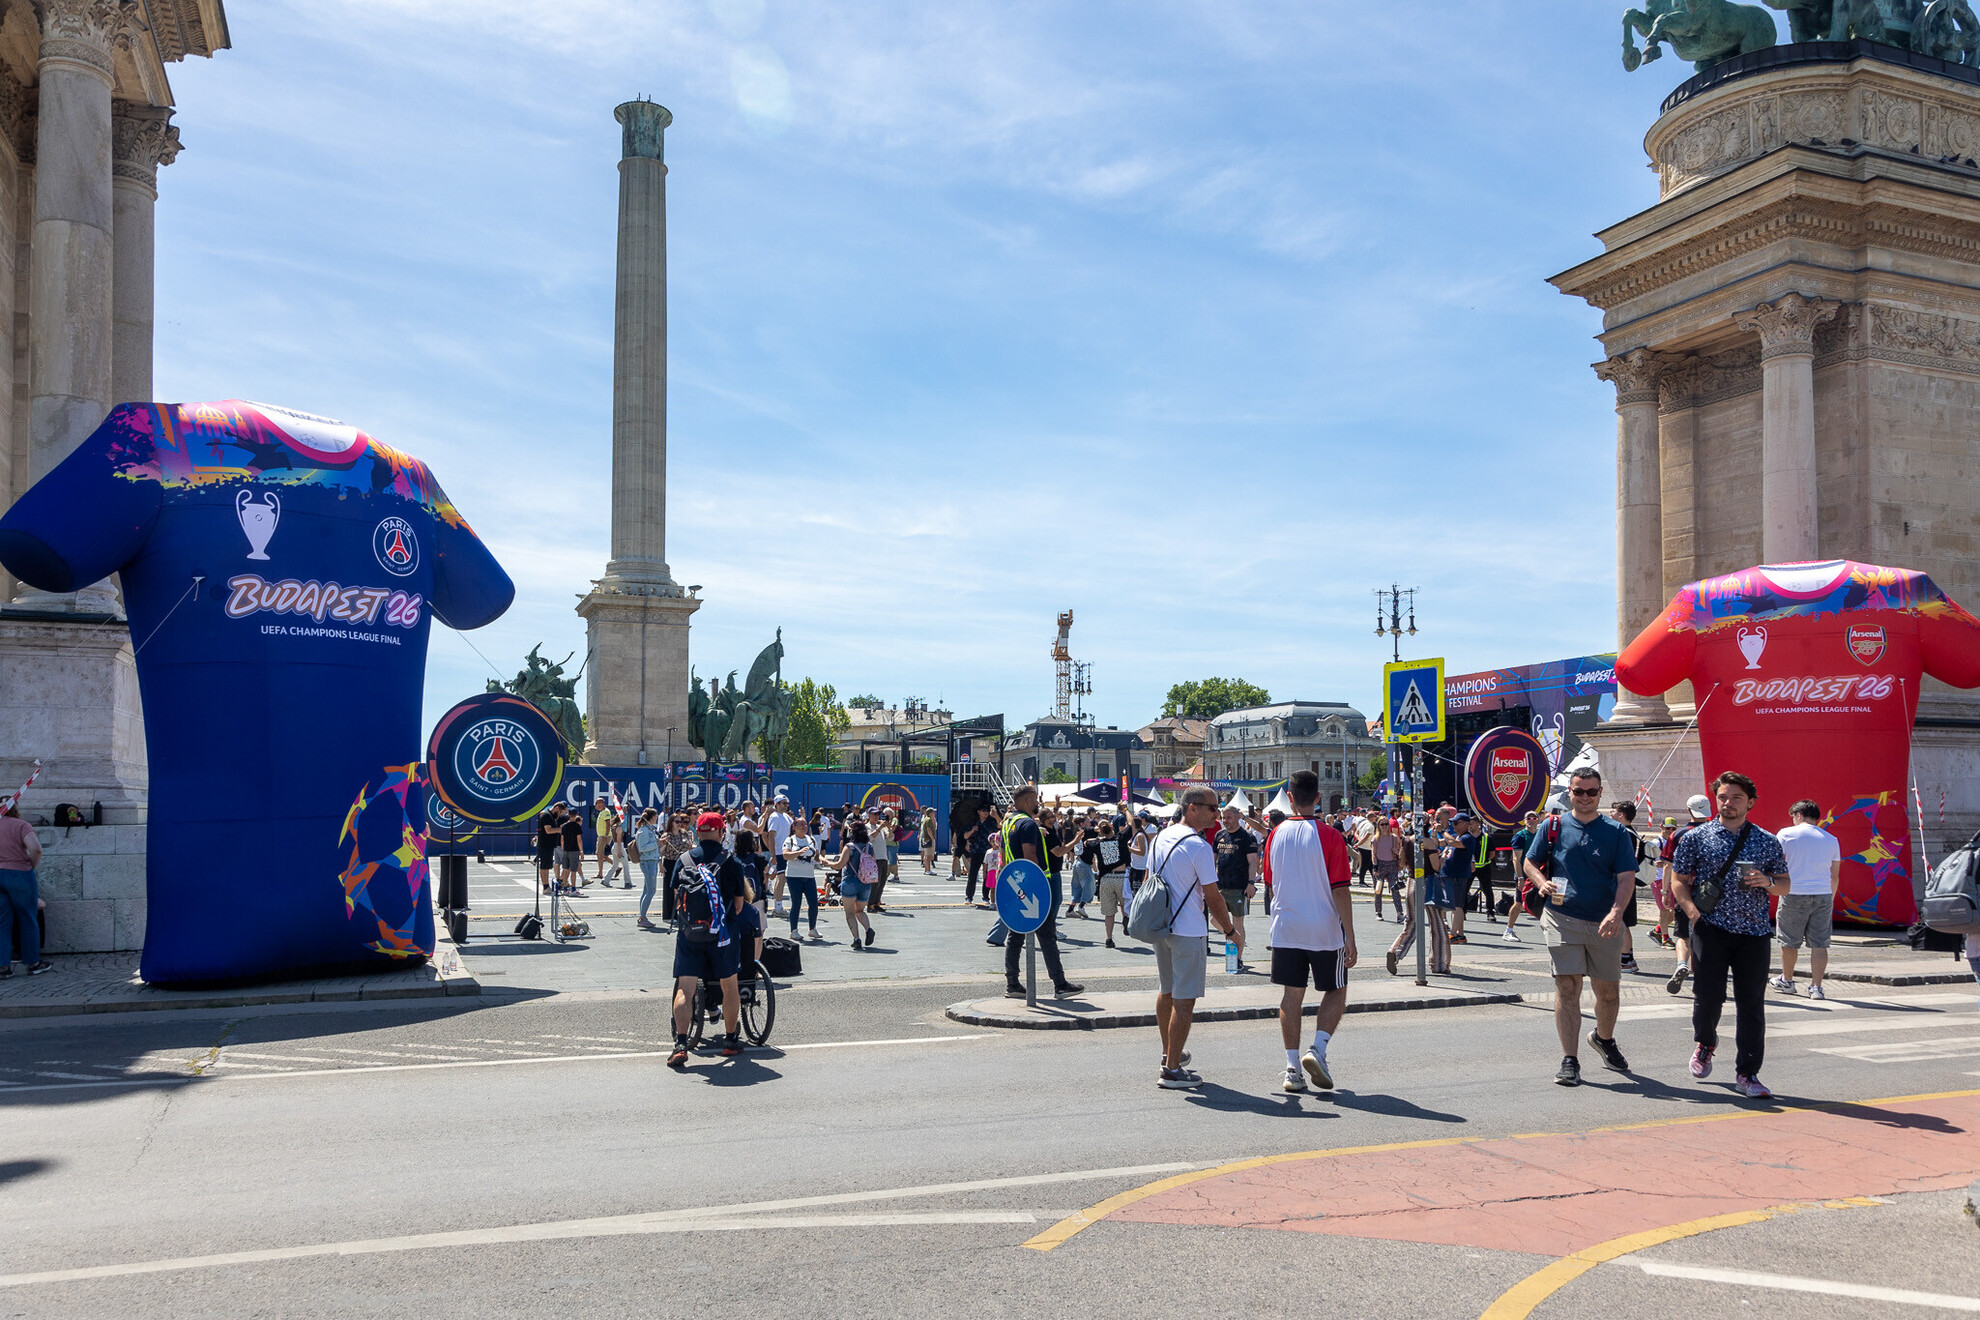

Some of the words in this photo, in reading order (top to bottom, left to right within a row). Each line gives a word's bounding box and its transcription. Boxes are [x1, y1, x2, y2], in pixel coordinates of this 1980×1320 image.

[382, 520, 412, 537] PARIS
[227, 576, 391, 623] BUDAPEST
[386, 592, 421, 626] 26
[261, 625, 287, 635] UEFA
[289, 626, 347, 639] CHAMPIONS
[348, 631, 380, 642] LEAGUE
[380, 634, 401, 645] FINAL
[1851, 629, 1882, 638] Arsenal
[1575, 668, 1614, 685] BUDAPEST
[1444, 677, 1496, 696] HAMPIONS
[1734, 676, 1860, 704] BUDAPEST
[1856, 675, 1893, 698] 26
[1449, 695, 1483, 708] FESTIVAL
[1775, 706, 1820, 714] CHAMPIONS
[469, 723, 526, 743] PARIS
[1493, 756, 1527, 768] Arsenal
[469, 777, 489, 793] SAINT
[494, 778, 524, 794] GERMAIN
[566, 780, 789, 808] CHAMPIONS
